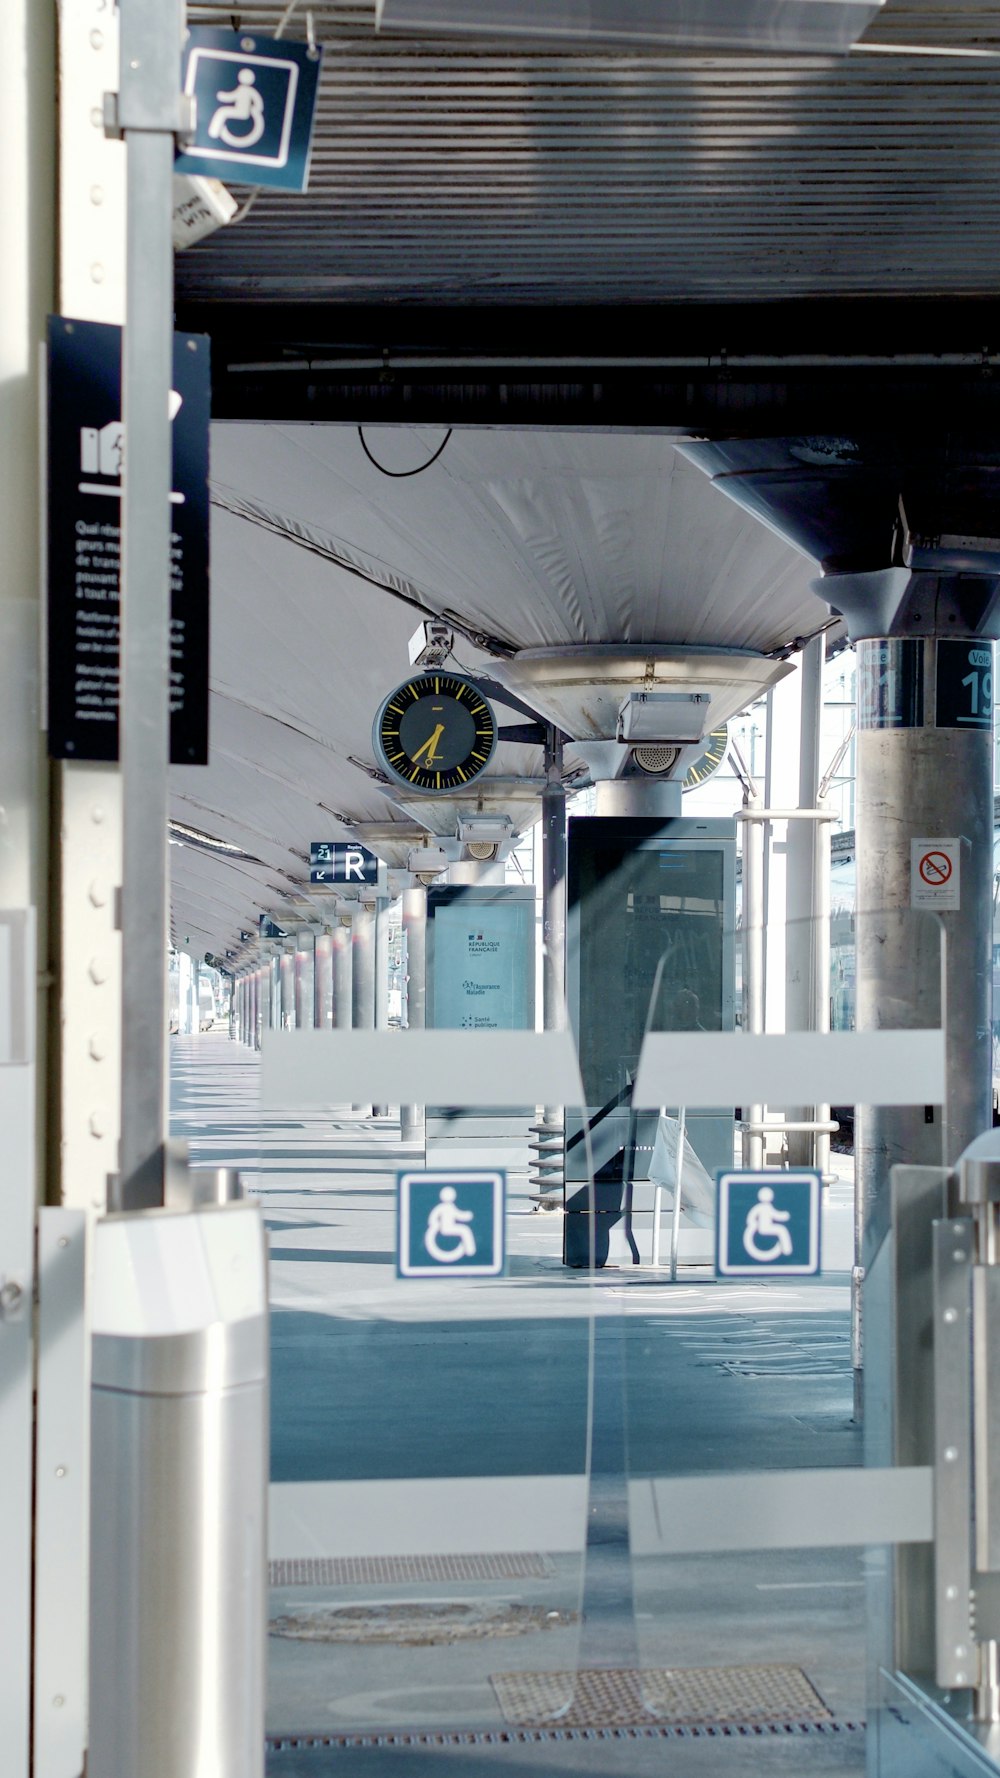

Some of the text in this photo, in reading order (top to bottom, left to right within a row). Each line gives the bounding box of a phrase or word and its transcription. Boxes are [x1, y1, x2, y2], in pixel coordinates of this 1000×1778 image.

[92, 556, 120, 569] trans
[961, 671, 992, 716] 19
[317, 849, 332, 860] 21
[345, 852, 365, 880] R
